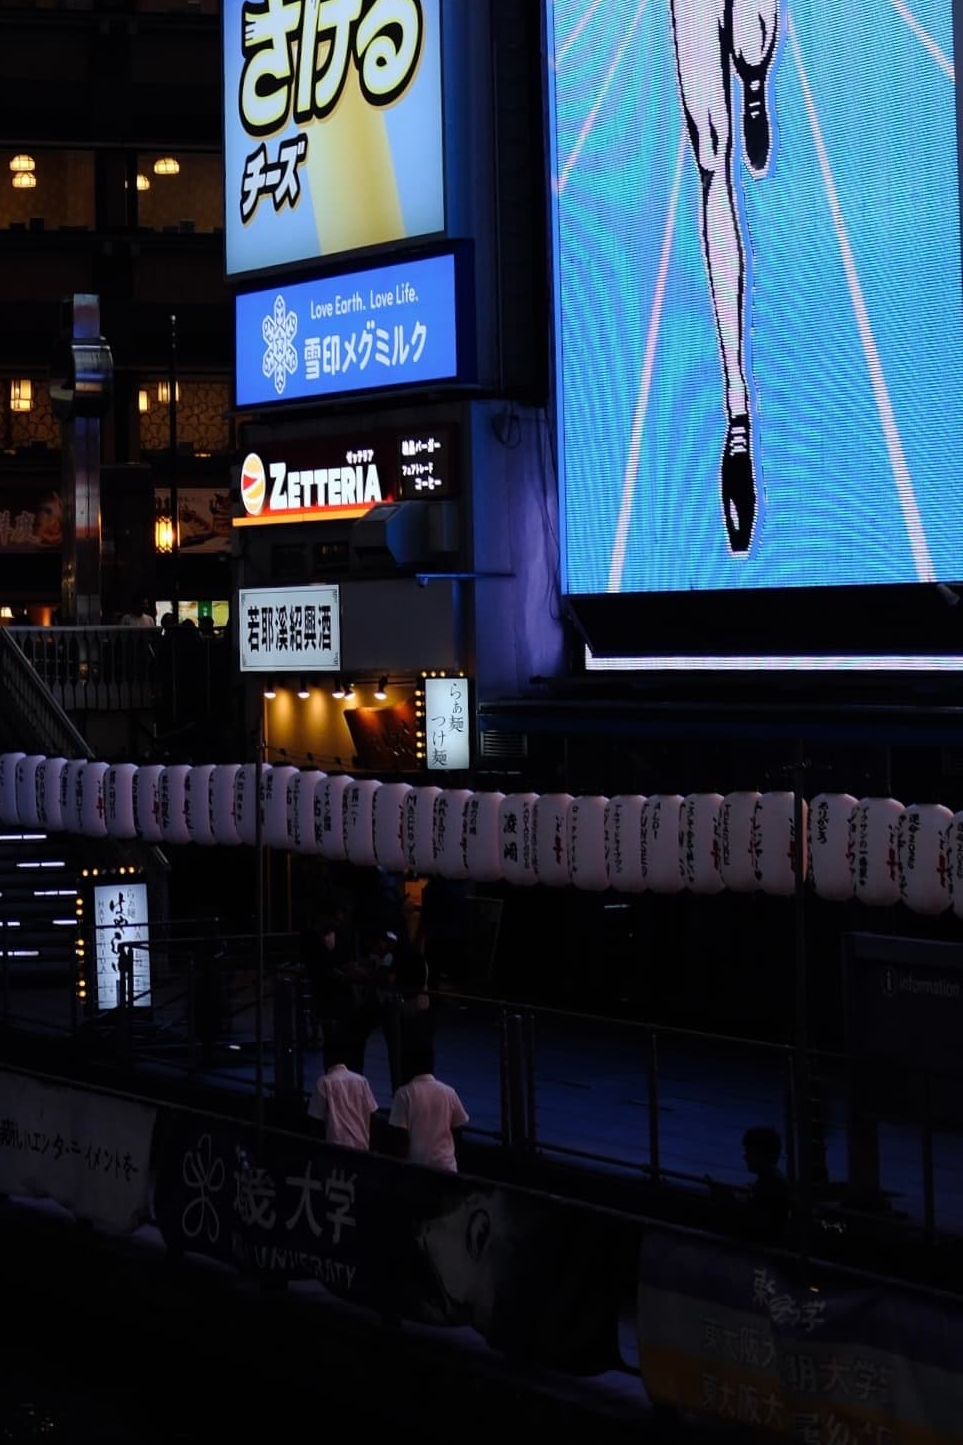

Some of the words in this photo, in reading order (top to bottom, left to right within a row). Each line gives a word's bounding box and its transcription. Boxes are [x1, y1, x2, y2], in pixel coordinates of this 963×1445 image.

[240, 132, 308, 225] チーズ
[310, 301, 333, 320] Love
[335, 291, 366, 315] Earth.
[370, 289, 394, 309] Love
[396, 282, 419, 304] Life.
[304, 320, 427, 380] 雪印メグミルク
[269, 462, 382, 511] ZETTERIA
[415, 476, 442, 490] コーヒー
[449, 683, 465, 733] らぁ麺
[432, 715, 446, 767] つけ麺
